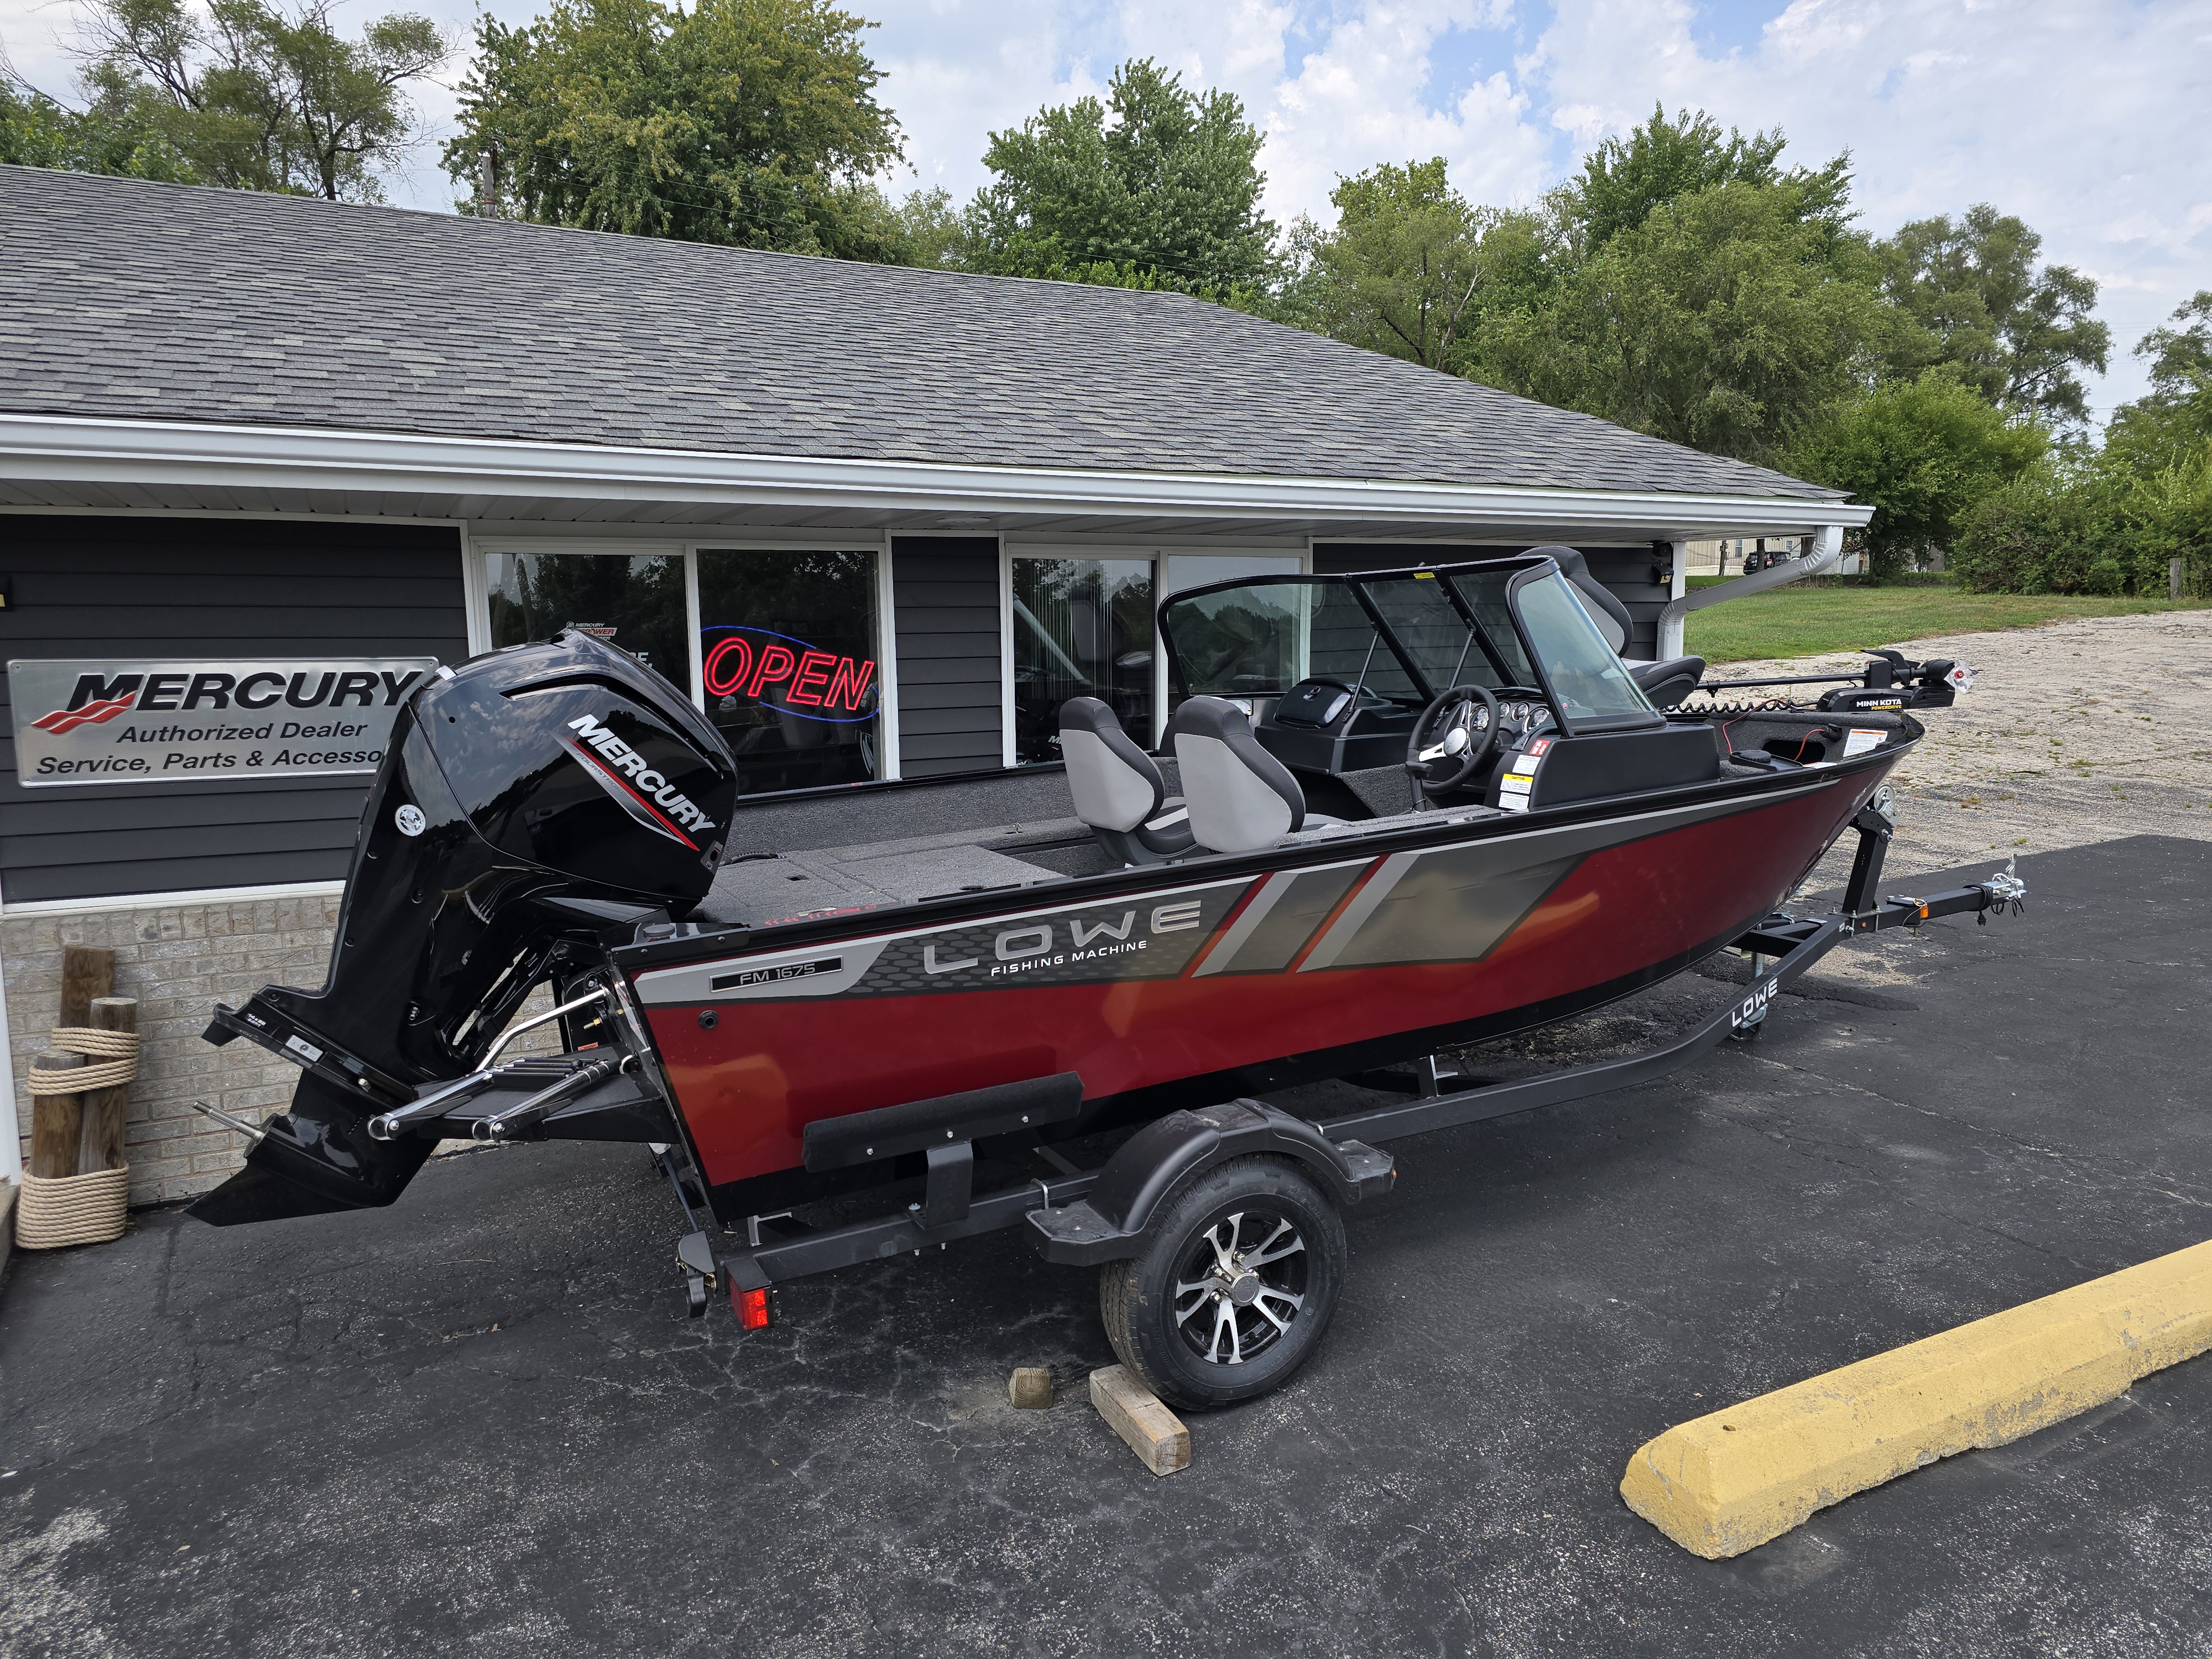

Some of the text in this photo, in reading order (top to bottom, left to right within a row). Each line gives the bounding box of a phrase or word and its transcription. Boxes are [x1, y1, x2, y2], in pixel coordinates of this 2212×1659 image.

[66, 671, 425, 712] MERCURY
[705, 637, 874, 711] OPEN
[116, 720, 368, 743] Authorized Dealer
[36, 755, 153, 775] Service,
[163, 750, 237, 770] Parts
[244, 750, 263, 767] &
[567, 714, 716, 832] MERCURY
[576, 752, 627, 796] FOURSTROKE
[924, 900, 1202, 974] LOWE
[739, 963, 816, 985] FM 1675
[990, 940, 1147, 977] FISHING MACHINE
[1732, 978, 1778, 1027] LOWE
